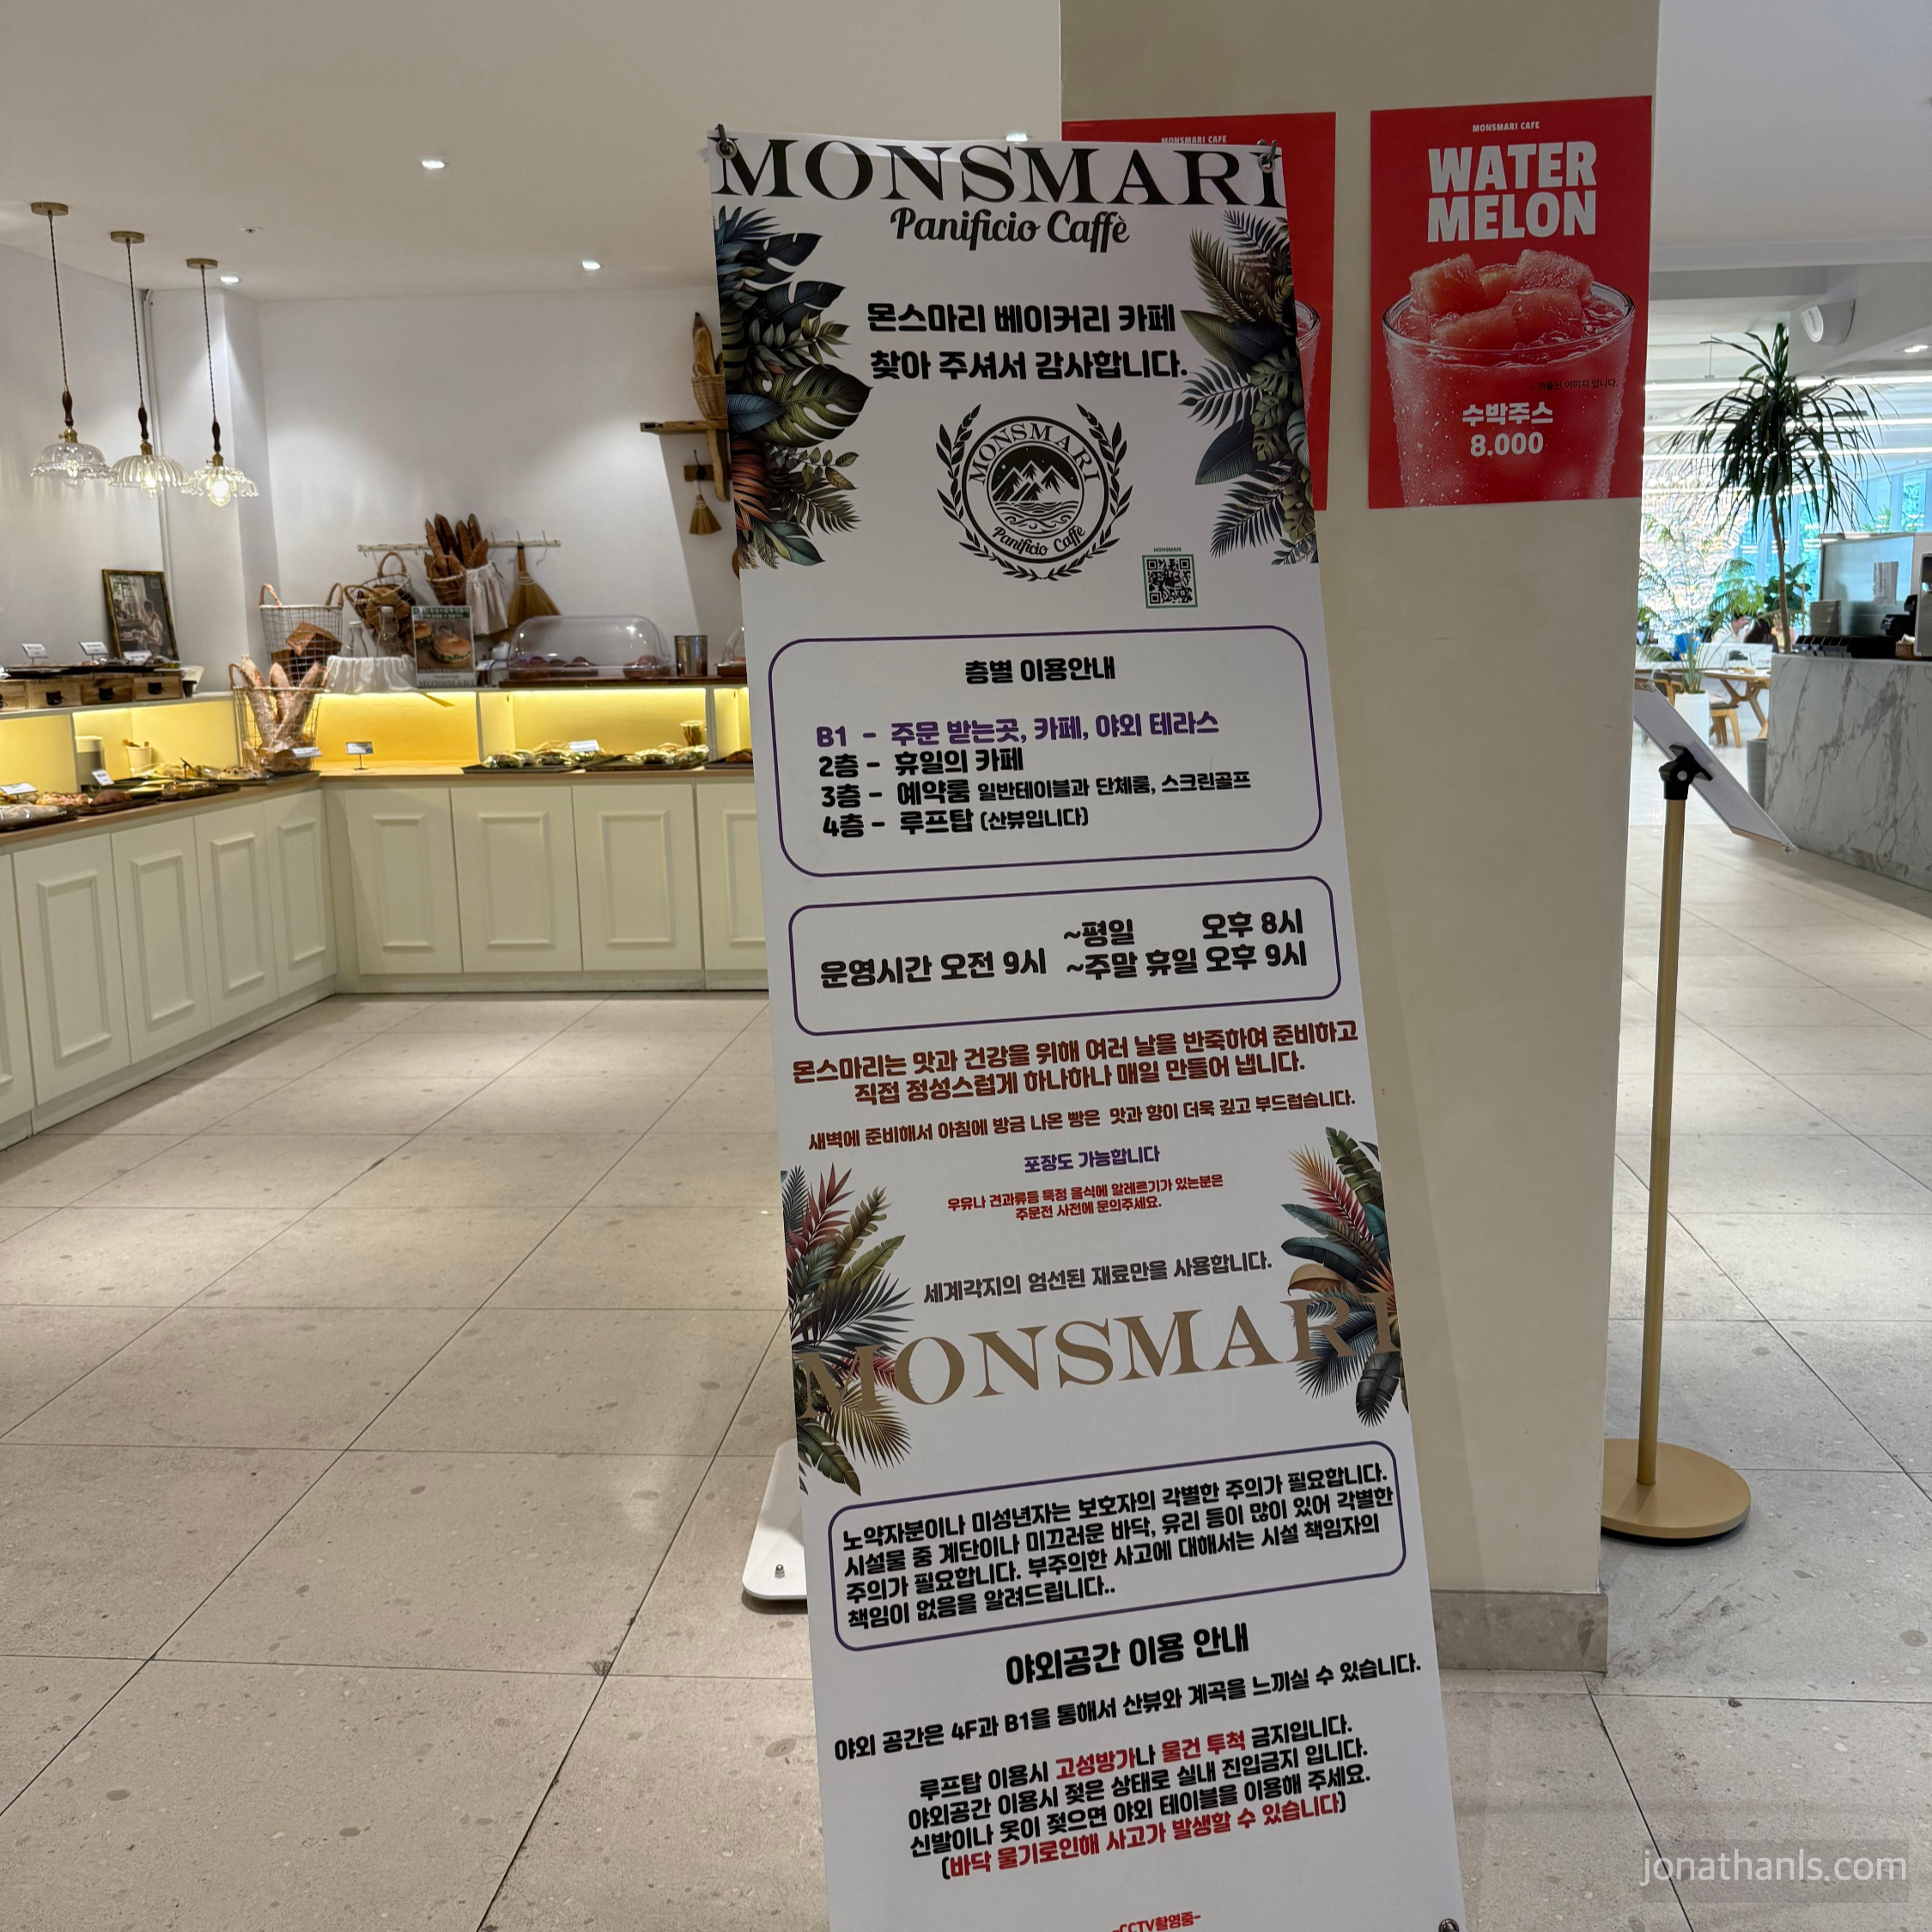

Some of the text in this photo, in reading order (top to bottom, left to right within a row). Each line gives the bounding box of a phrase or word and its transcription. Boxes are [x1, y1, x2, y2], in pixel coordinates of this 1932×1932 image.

[1472, 121, 1540, 132] MONSMARI CAFE
[707, 137, 1286, 208] MONSMARI
[1428, 141, 1597, 193] WATER
[890, 206, 1130, 253] Panificio Caffè
[1427, 190, 1596, 243] MELON
[867, 302, 1176, 332] 몬스마리 베이커리 카페
[870, 349, 1188, 380] 찾아 주셔서 감사합니다.
[1564, 380, 1589, 390] 이미지
[1591, 379, 1619, 389] 입니다.
[1462, 401, 1553, 427] 수박주스
[969, 422, 1101, 486] MONSMARI
[1470, 432, 1544, 457] 8.000
[992, 525, 1086, 556] Panificio Caffè
[418, 679, 476, 688] MONSMARI
[965, 655, 1115, 684] 층별 이용안내
[816, 710, 1218, 747] B1 주문 받는곳, 카페, 야외 테라스
[818, 746, 1023, 778] 2층 휴일의 카페
[821, 770, 1251, 808] 3층 예약룸 일반테이블과 단체룸, 스크린골프
[823, 806, 1088, 837] 4층 루프탑 (산뷰입니다)
[1063, 908, 1303, 947] ~평일 오후 8시
[820, 939, 1307, 988] 운영시간 오전 9시 ~주말 휴일 오후 9시
[793, 1019, 1358, 1084] 몬스마리는 맛과 건강을 위해 여러 날을 반죽하여 준비하고
[854, 1049, 1304, 1105] 직접 정성스럽게 하나하나 매일 만들어 냅니다.
[808, 1089, 1355, 1150] 새벽에 준비해서 아침에 방금 나온 빵은 맛과 향이 더욱 깊고 부드럽습니다.
[1024, 1145, 1159, 1173] 포장도 가능합니다
[947, 1174, 1223, 1211] 우유나 견과류등 특정 음식에 알레르기가 있는분은
[1016, 1195, 1161, 1220] 주문전 사전에 문의주세요.
[923, 1250, 1272, 1303] 세계각지의 엄선된 재료만을 사용합니다.
[792, 1291, 1402, 1419] MONSMARI
[843, 1462, 1387, 1551] 노약자분이나 미성년자는 보호자의 각별한 주의가 필요합니다.
[844, 1485, 1394, 1577] 시설물 중 계단이나 미끄러운 바닥, 유리 등이 많이 있어 각별한
[846, 1512, 1379, 1603] 주의가 필요합니다. 부주의한 사고에 대해서는 시설 책임자의
[848, 1575, 1115, 1629] 책임이 없음을 알려드립니다..
[1005, 1622, 1249, 1685] 야외공간 이용 안내
[835, 1652, 1420, 1760] 야외 공간은 4F과 B1을 통해서 산뷰와 계곡을 느끼실 수 있습니다.
[910, 1763, 1370, 1857] 신발이나 옷이 젖으면 야외 테이블을 이용해 주세요.
[941, 1790, 1346, 1880] (바닥 물기로인해 사고가 발생할 수 있습니다)
